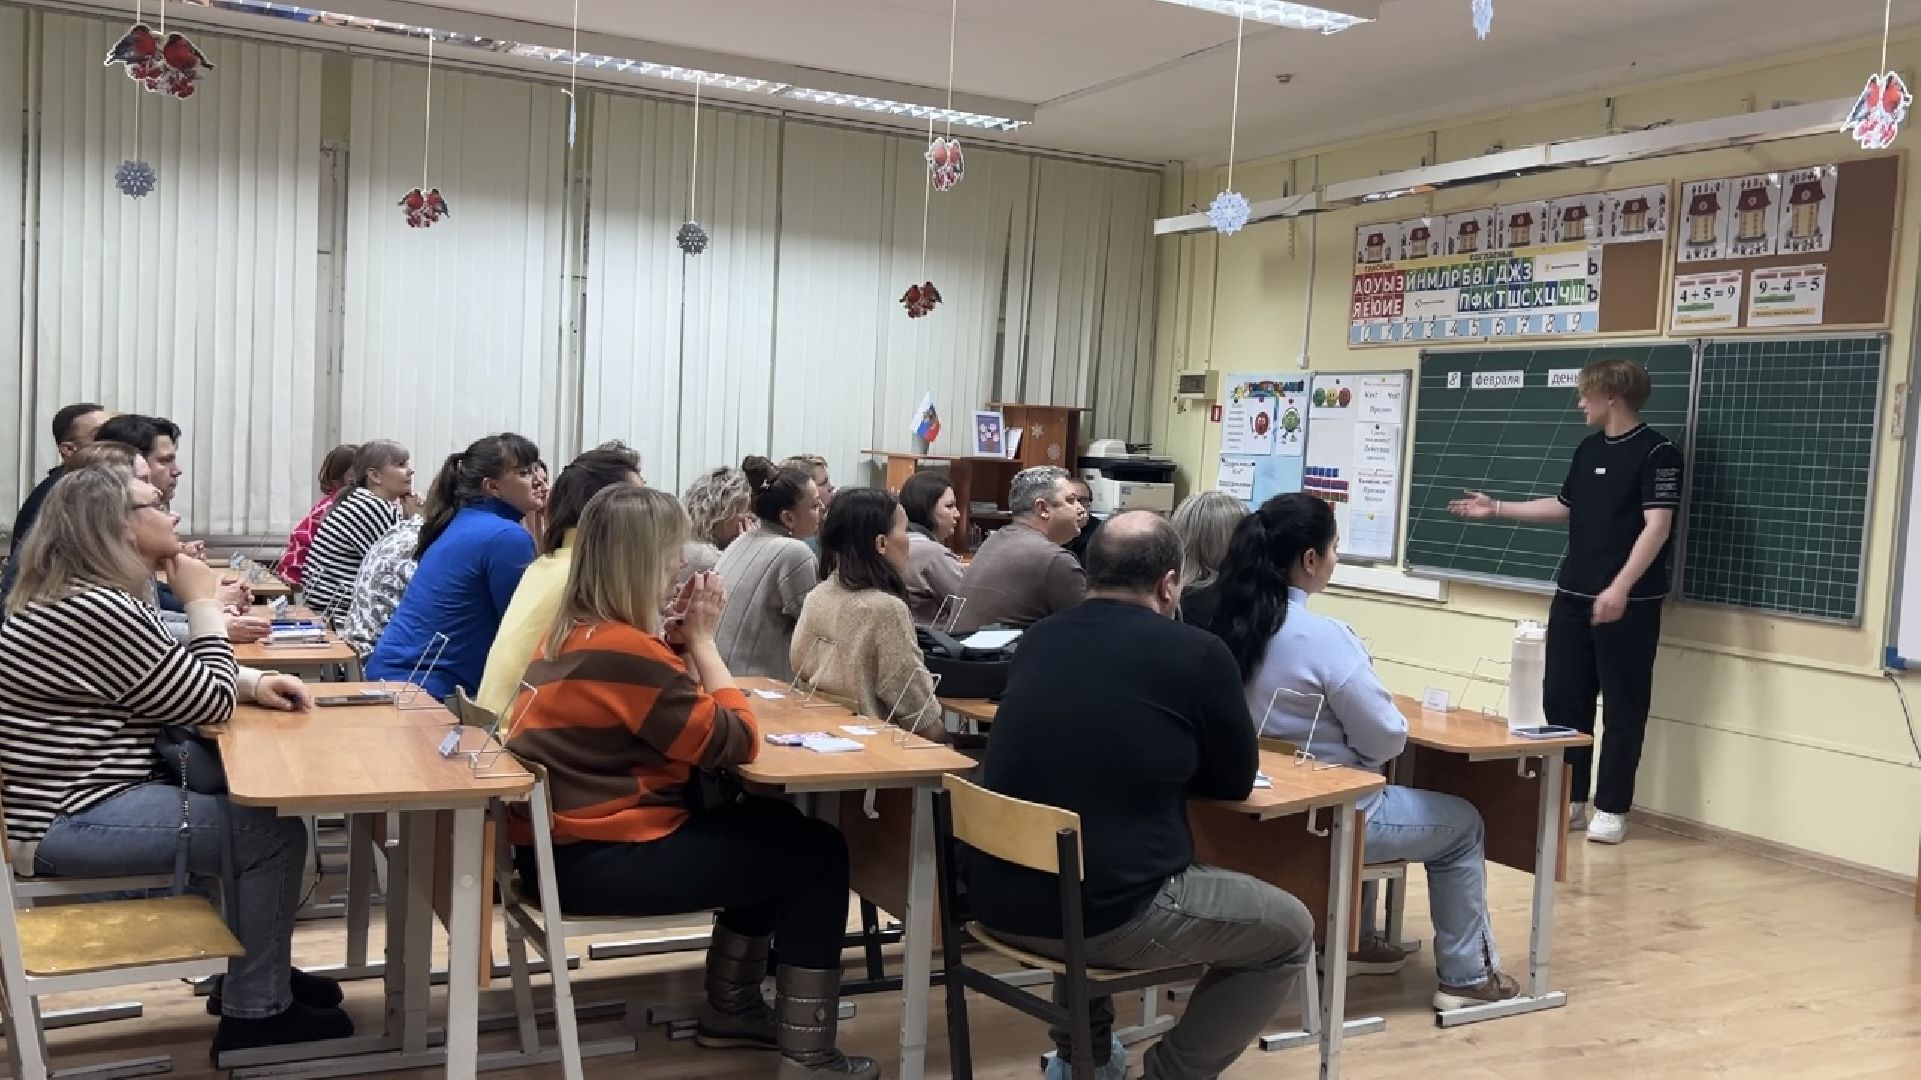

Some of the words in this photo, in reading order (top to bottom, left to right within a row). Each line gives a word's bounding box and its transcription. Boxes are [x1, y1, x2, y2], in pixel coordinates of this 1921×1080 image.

[1703, 288, 1711, 300] 5
[1728, 285, 1735, 299] 9
[1759, 281, 1768, 294] 9
[1810, 278, 1820, 291] 5
[1475, 373, 1520, 388] февраля
